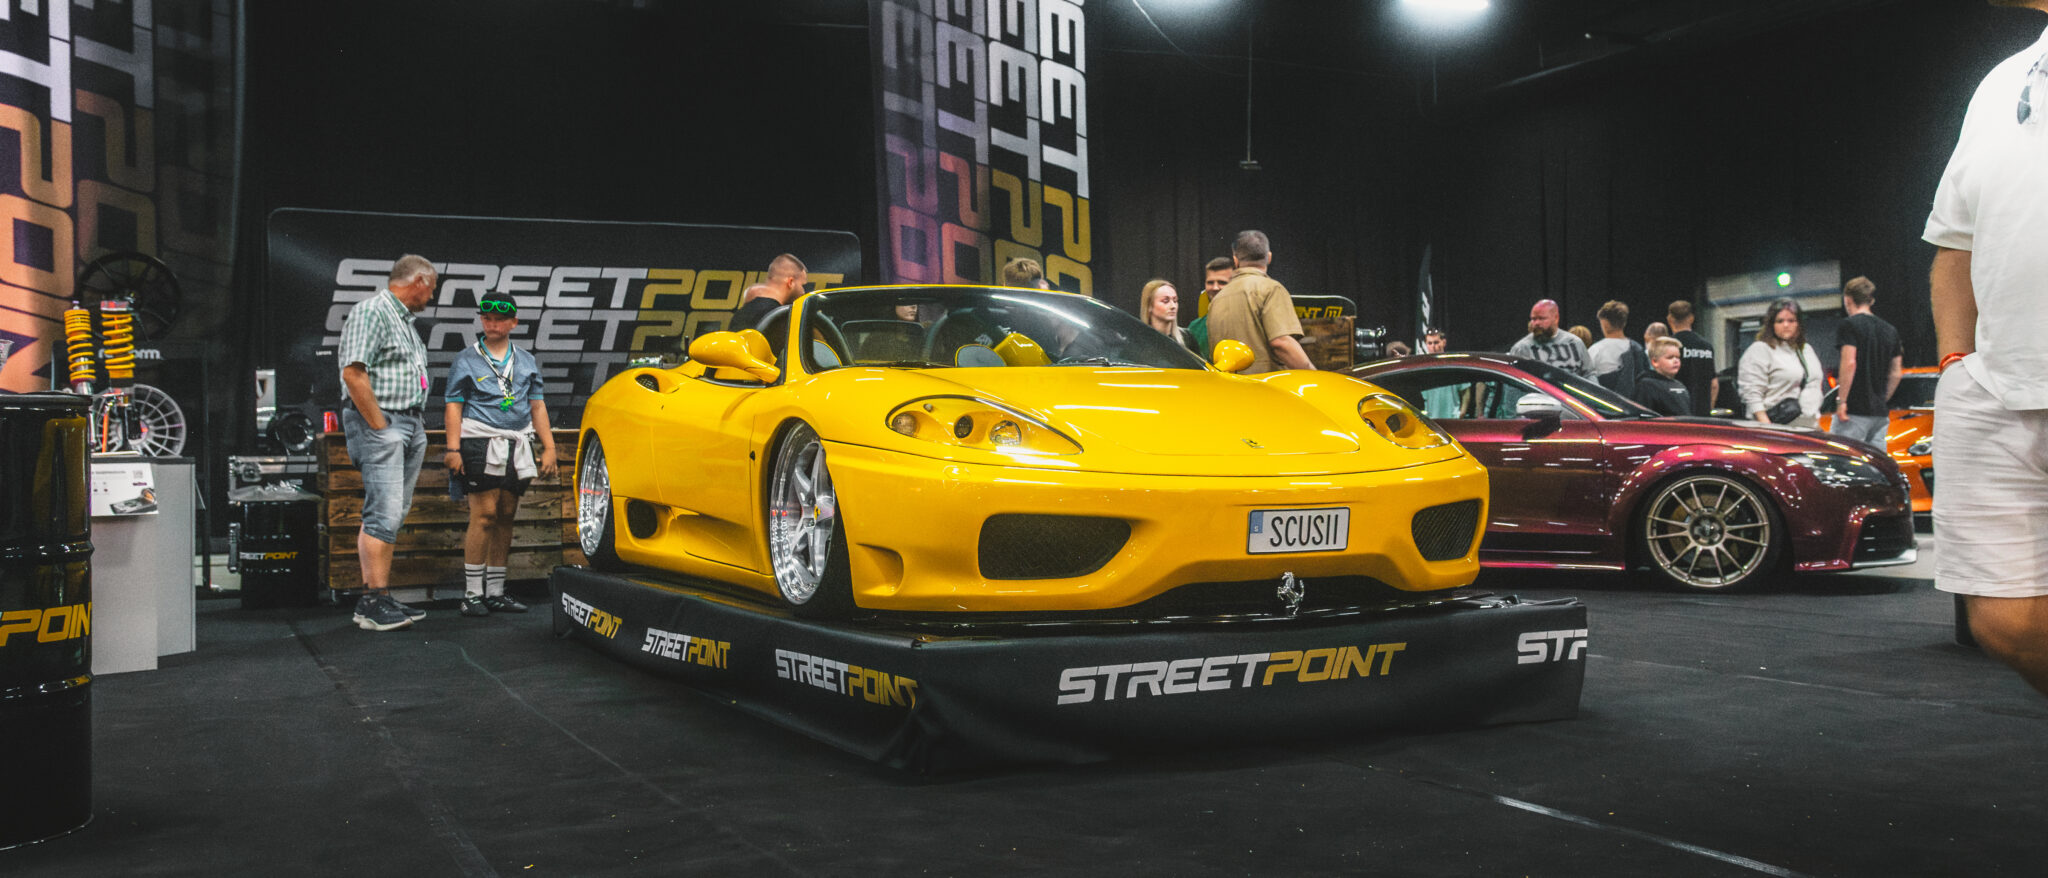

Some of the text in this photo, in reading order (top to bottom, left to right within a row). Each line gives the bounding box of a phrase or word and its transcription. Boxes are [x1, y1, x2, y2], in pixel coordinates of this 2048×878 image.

[0, 602, 92, 647] POIN
[561, 592, 622, 639] STREETPOINT
[641, 627, 731, 669] STREETPOINT
[775, 648, 918, 709] STREETPOINT
[1057, 642, 1406, 705] STREETPOINT
